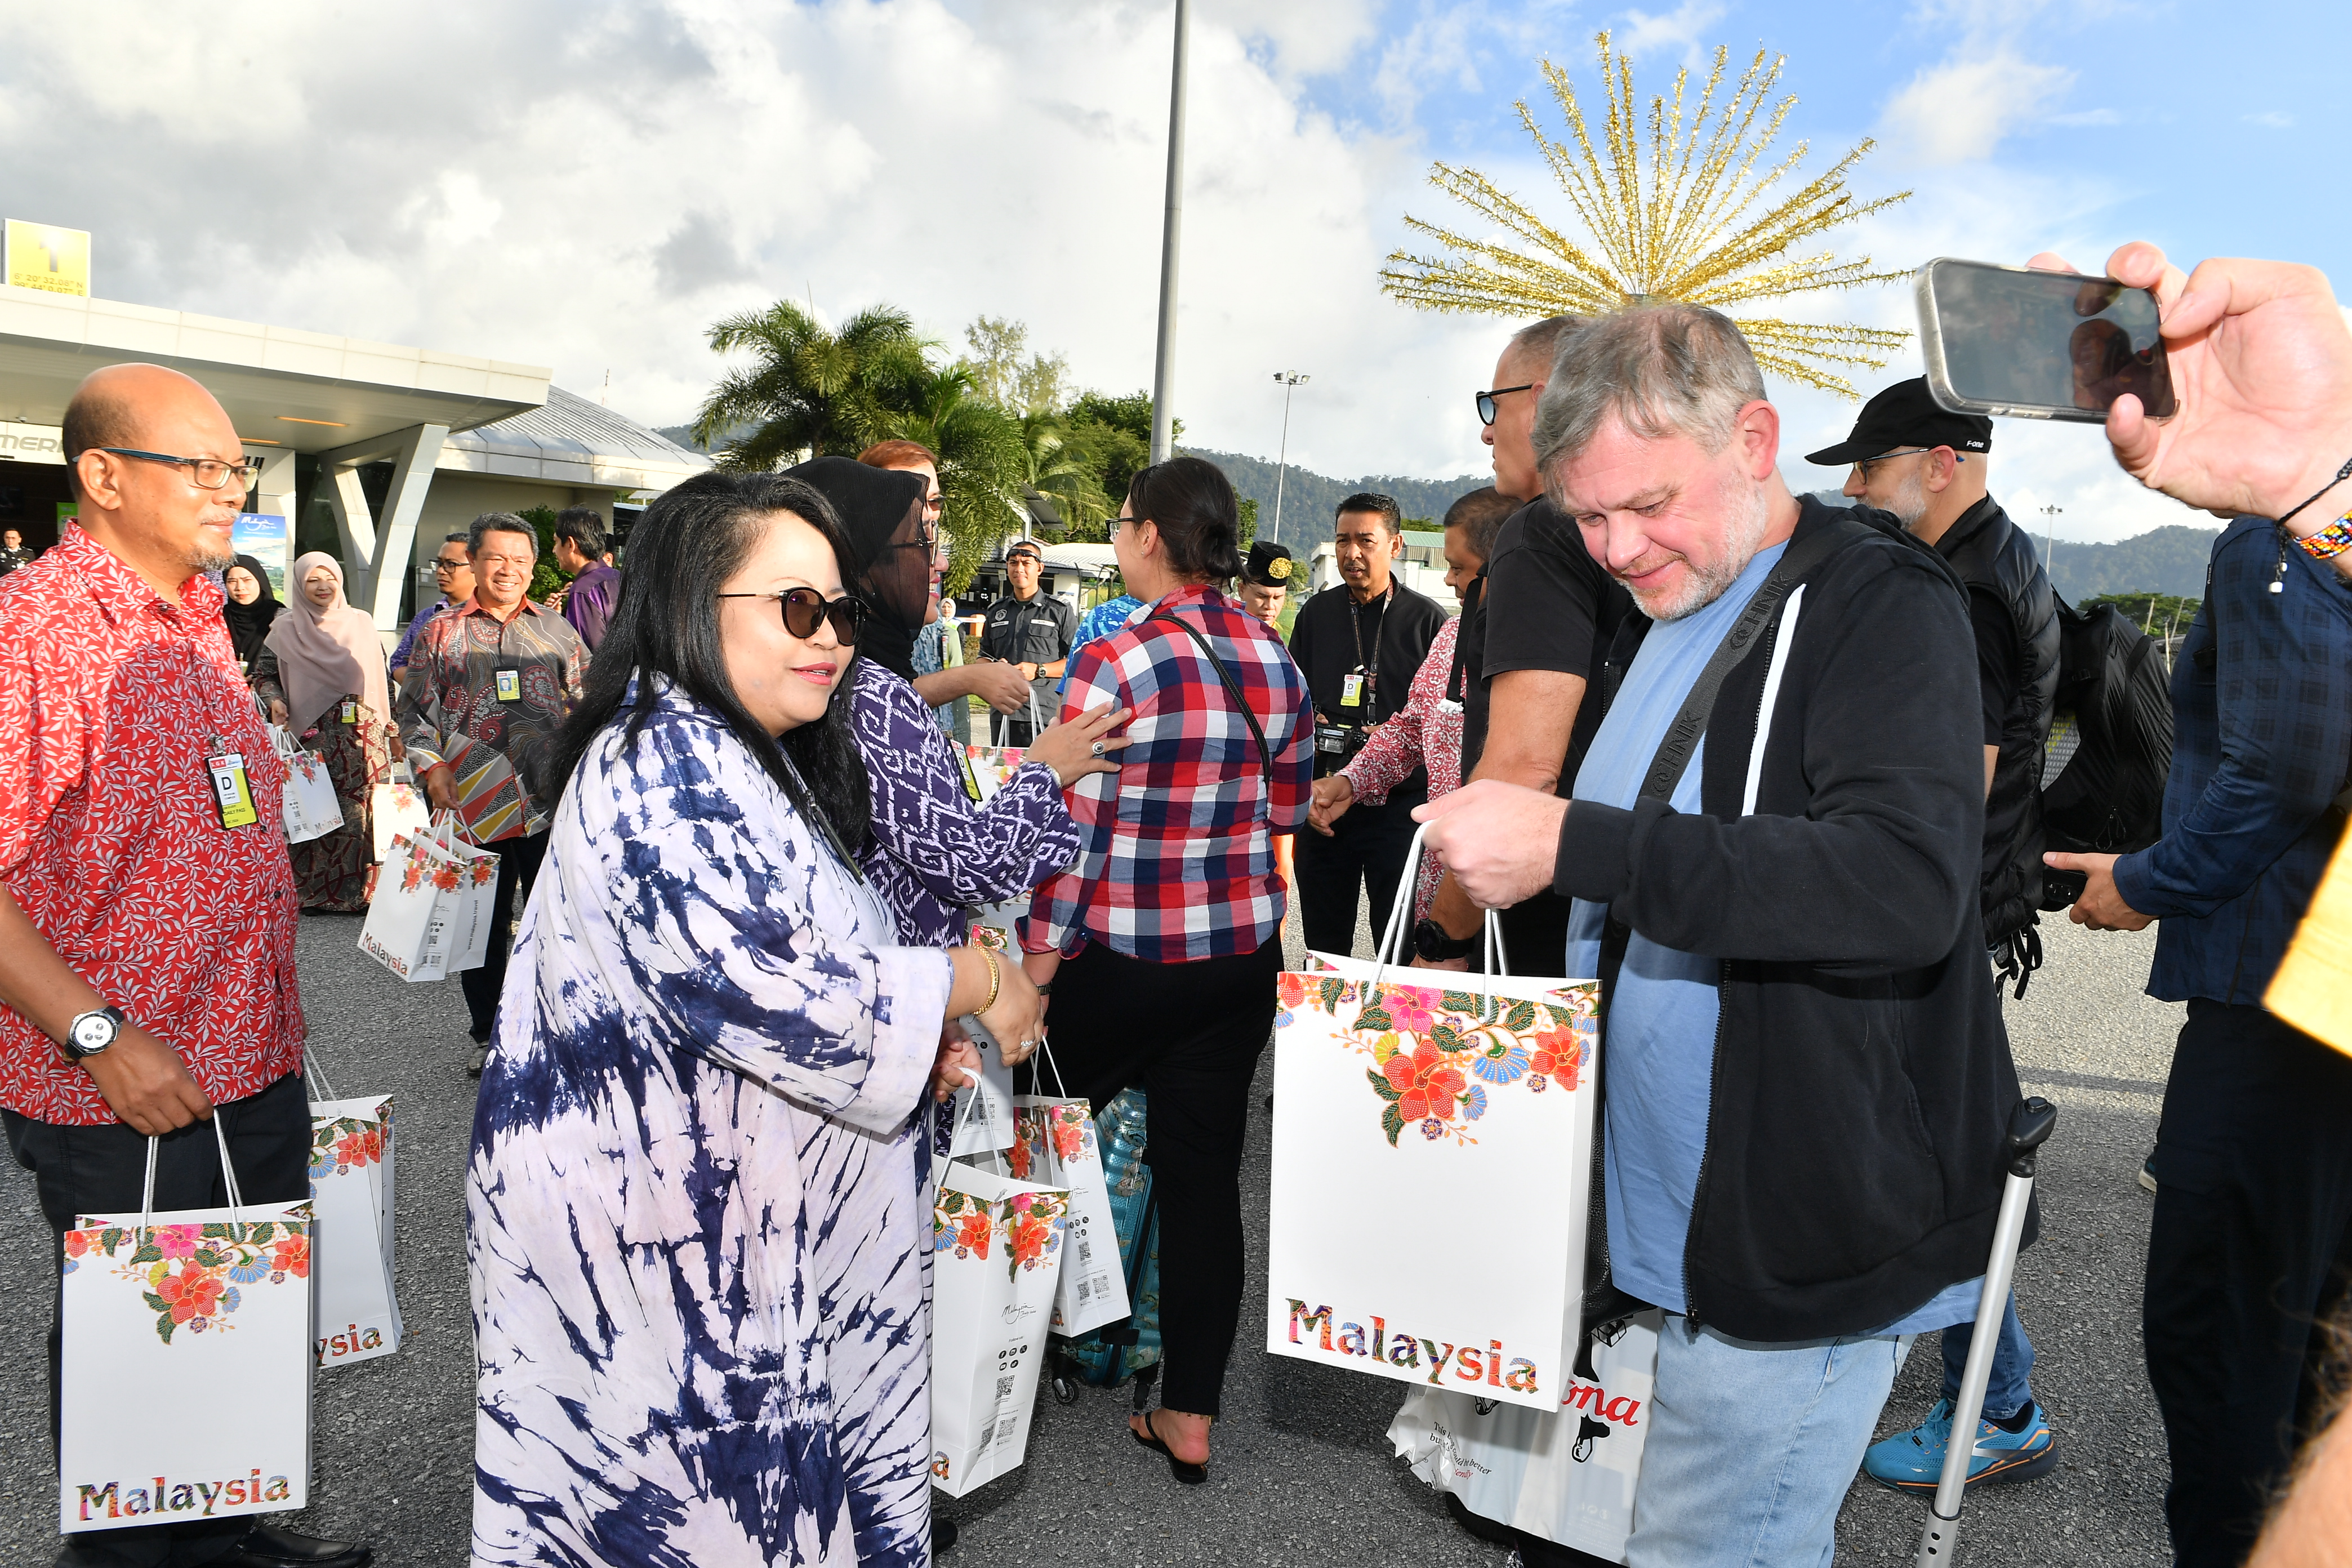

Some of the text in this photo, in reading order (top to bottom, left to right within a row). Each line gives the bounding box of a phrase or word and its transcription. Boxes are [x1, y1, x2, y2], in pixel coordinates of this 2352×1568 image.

[959, 756, 965, 768] D
[221, 776, 232, 791] D
[362, 931, 407, 975] Malaysia
[1285, 1297, 1539, 1395] Malaysia
[1469, 1458, 1492, 1475] better
[75, 1468, 291, 1521] Malaysia
